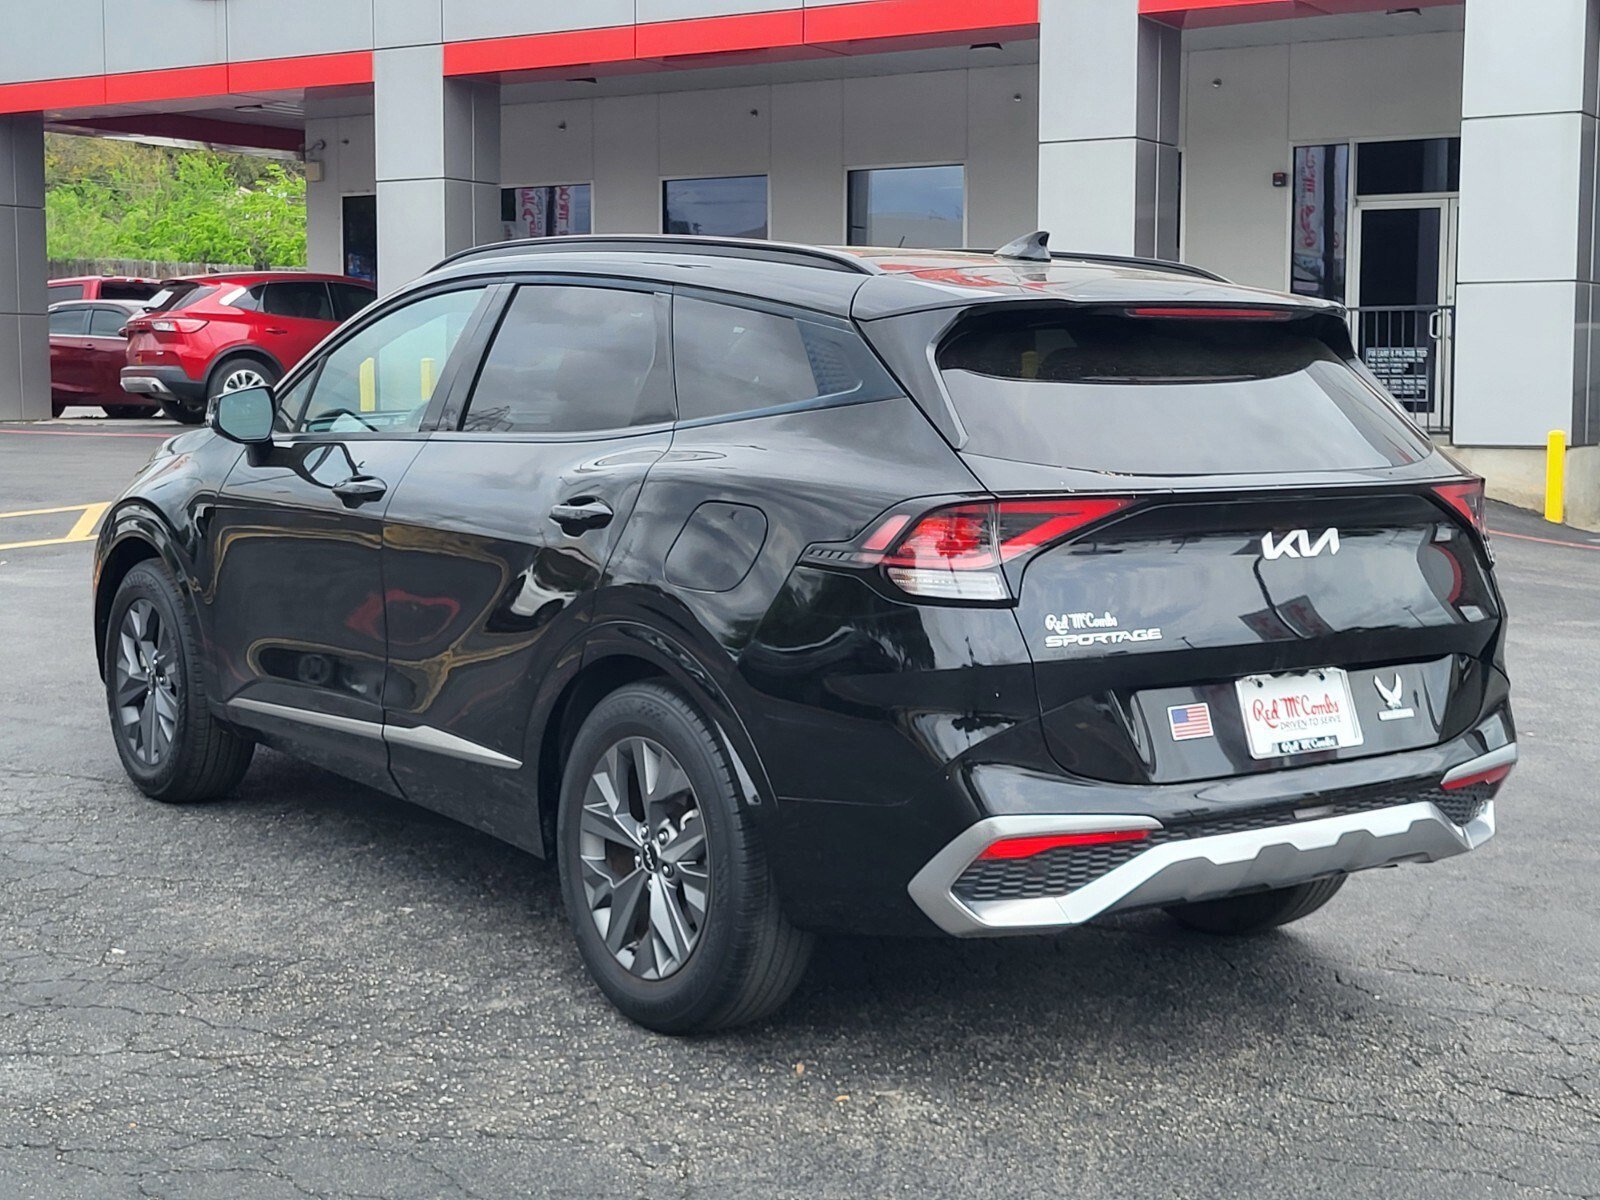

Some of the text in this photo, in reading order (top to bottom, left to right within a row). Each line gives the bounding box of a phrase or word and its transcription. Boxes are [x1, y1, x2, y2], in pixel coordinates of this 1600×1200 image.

[1261, 527, 1340, 560] KIA
[1045, 614, 1069, 635] Red
[1045, 628, 1163, 648] SPORTAGE
[1252, 693, 1340, 729] Red McCombs
[1280, 720, 1307, 731] DRIVEN
